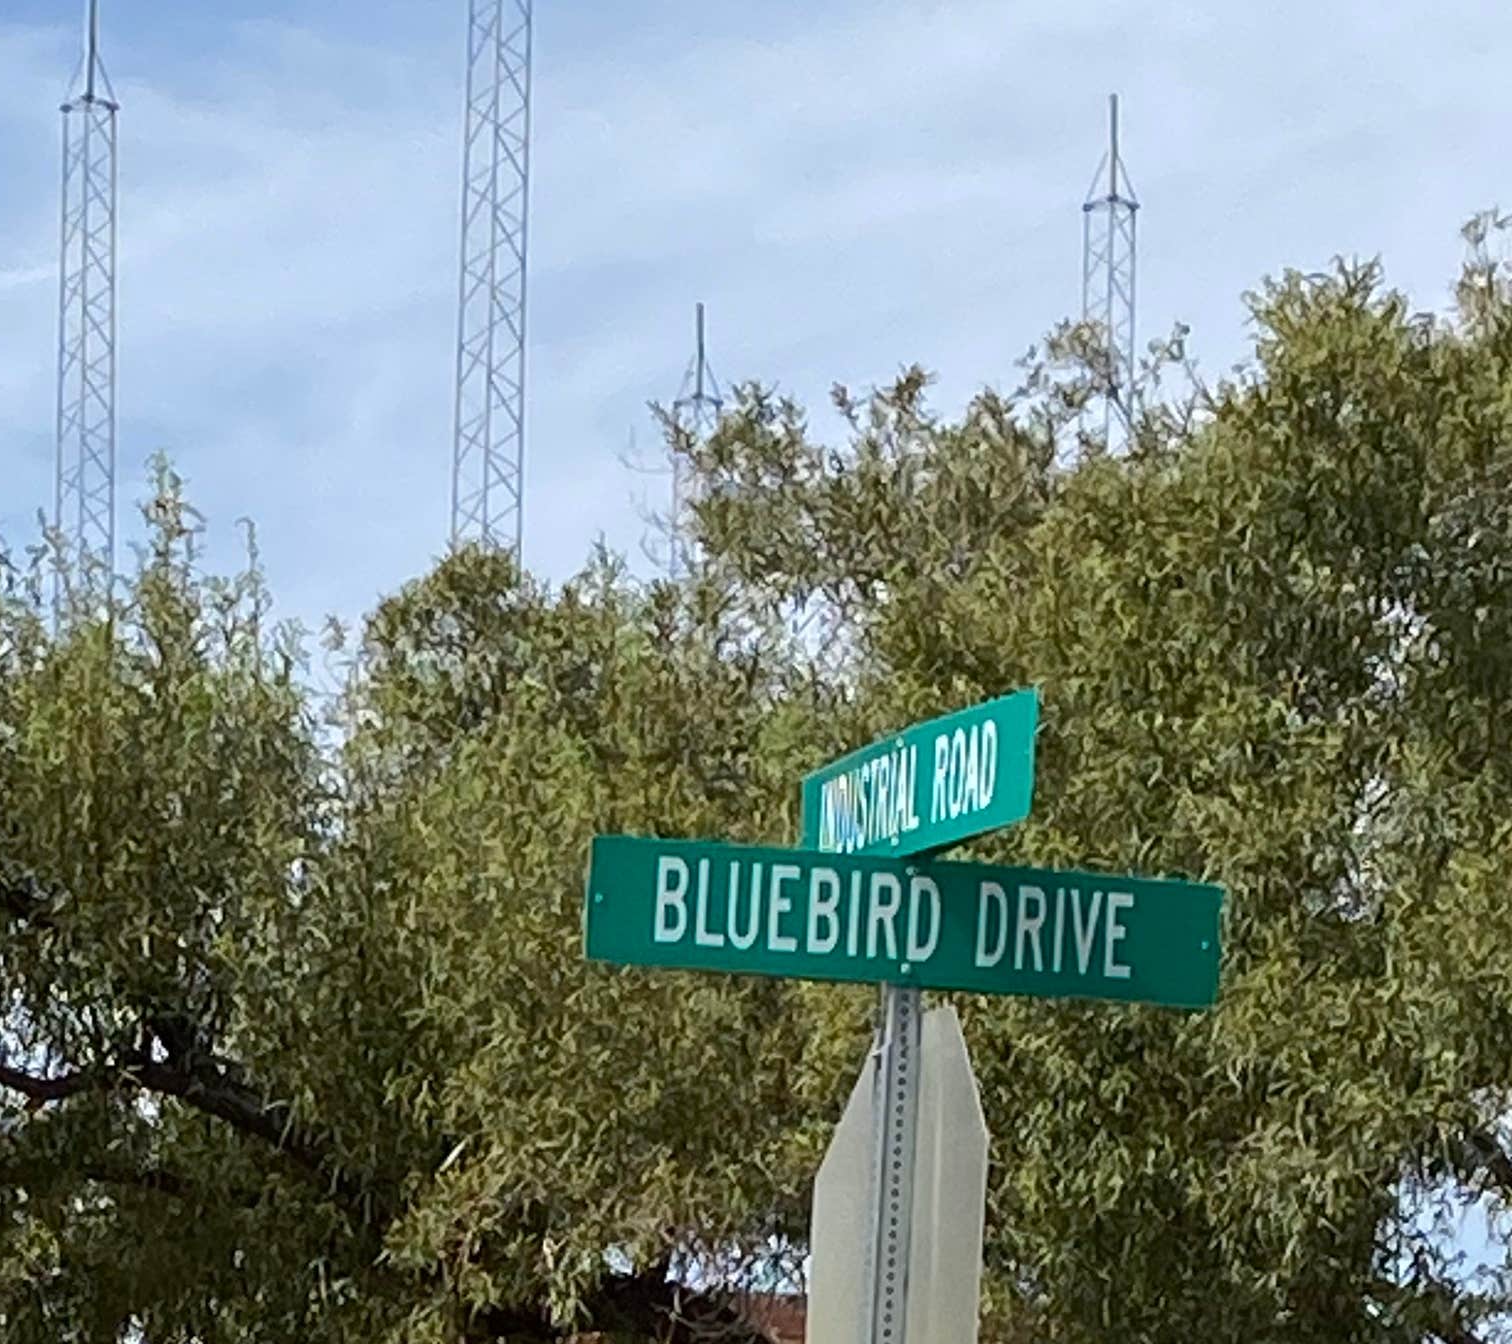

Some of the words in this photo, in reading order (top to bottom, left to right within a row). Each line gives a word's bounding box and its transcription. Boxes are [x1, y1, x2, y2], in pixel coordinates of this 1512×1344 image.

[819, 744, 920, 854] INDUSTRIAL
[930, 718, 999, 824] ROAD
[653, 854, 941, 963] BLUEBIRD
[975, 881, 1134, 979] DRIVE
